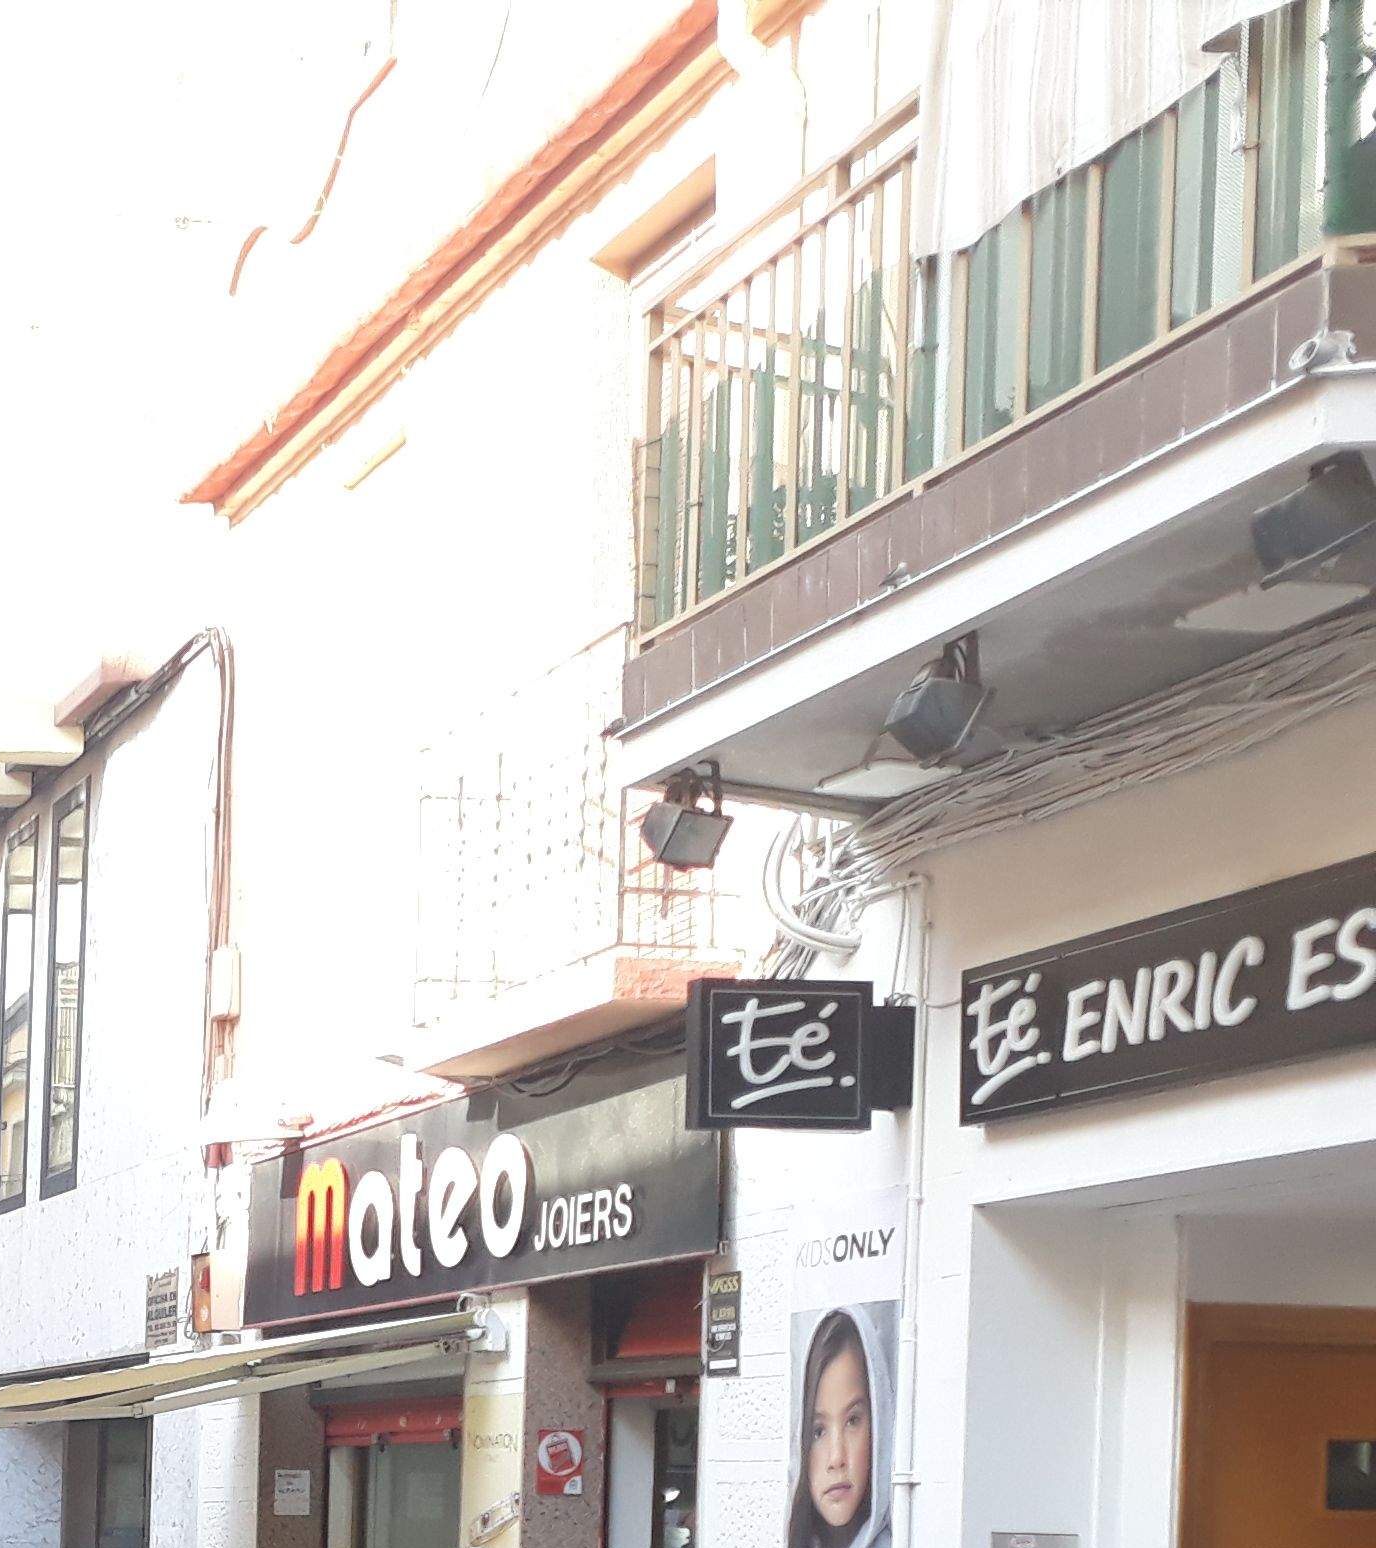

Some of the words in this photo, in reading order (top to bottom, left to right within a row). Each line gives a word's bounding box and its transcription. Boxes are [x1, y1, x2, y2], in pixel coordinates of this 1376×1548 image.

[1062, 935, 1265, 1063] ENRIC
[1286, 907, 1376, 1012] ES
[294, 1132, 528, 1297] mateo
[534, 1182, 635, 1252] JOIERS
